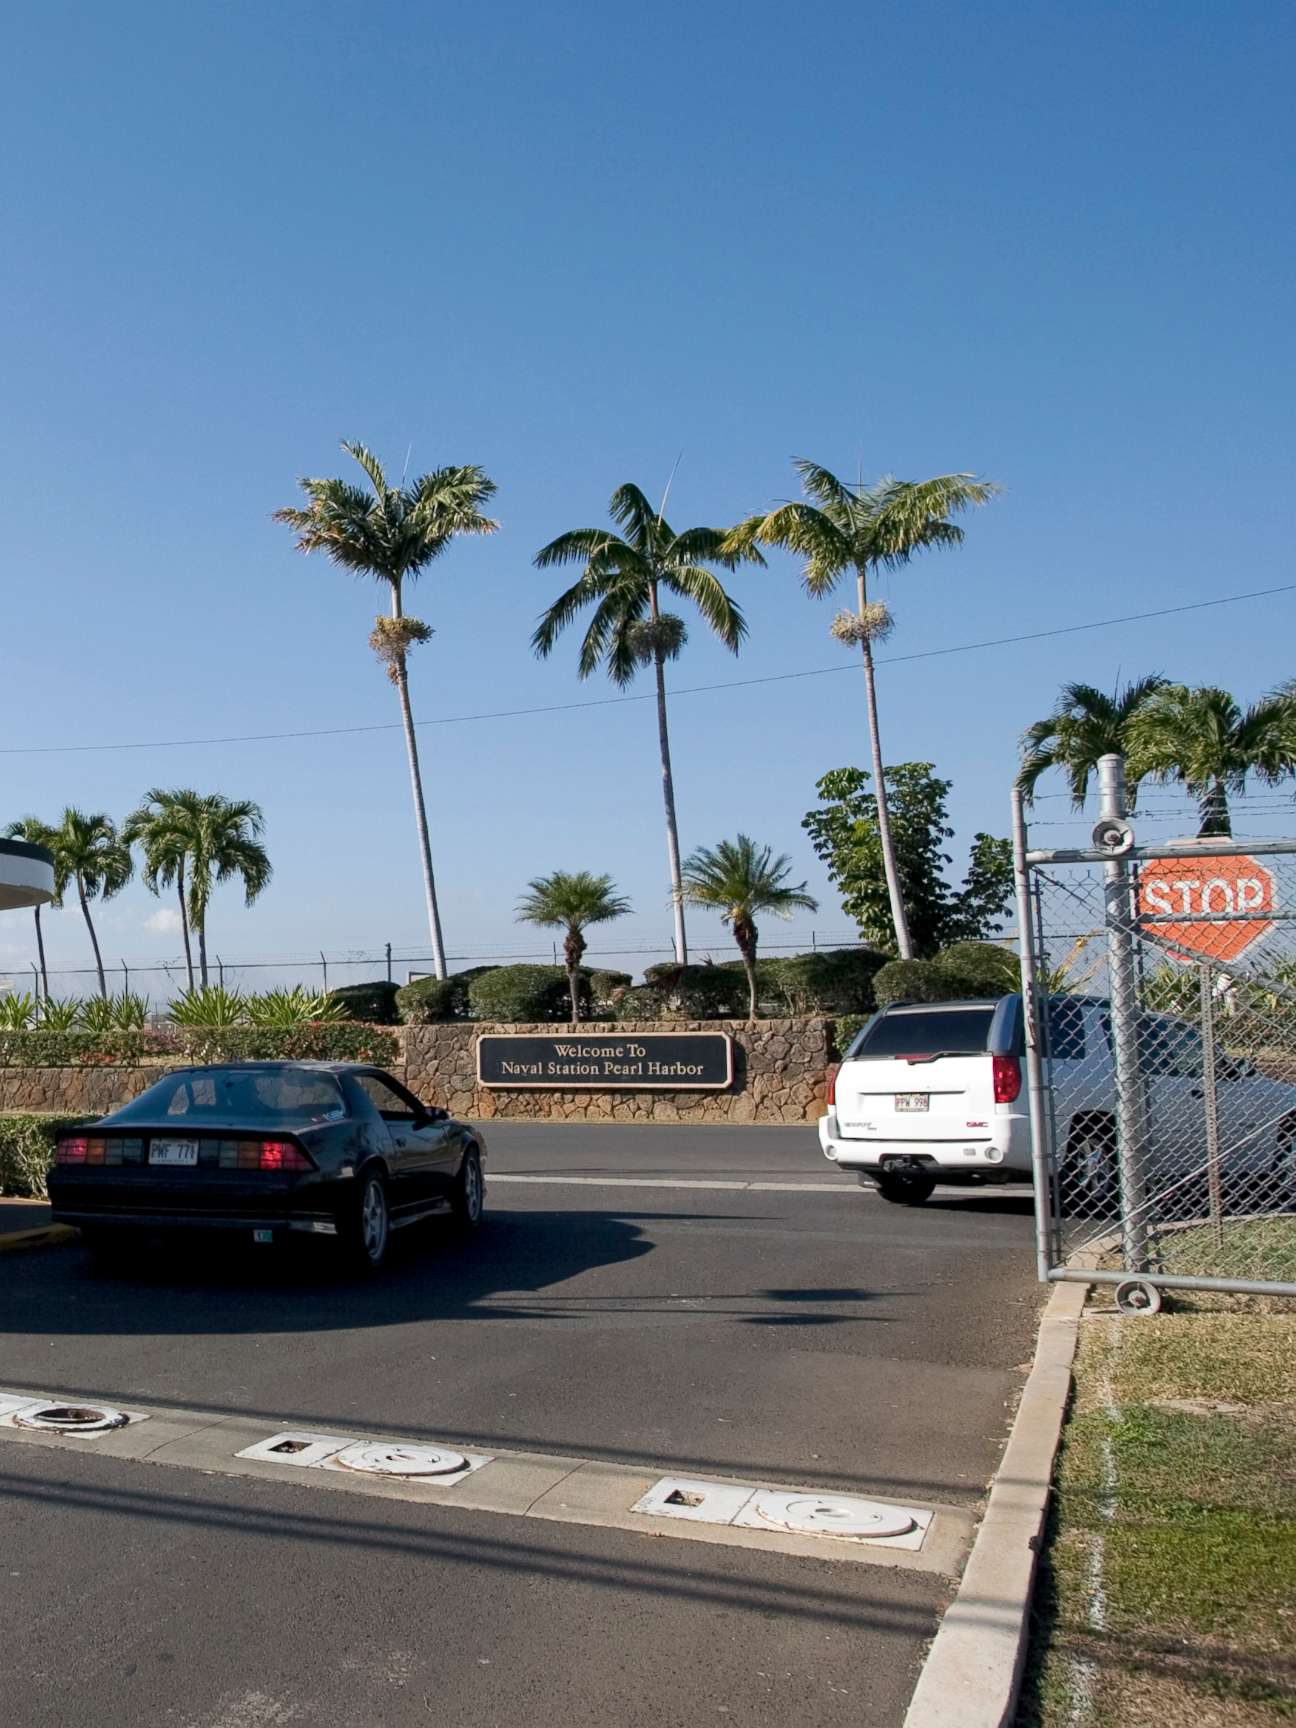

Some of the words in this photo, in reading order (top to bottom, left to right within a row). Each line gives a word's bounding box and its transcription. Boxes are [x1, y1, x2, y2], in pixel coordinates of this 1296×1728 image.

[1145, 877, 1264, 925] STOP
[554, 1043, 624, 1058] Welcome
[625, 1043, 647, 1058] To
[501, 1061, 543, 1075] Naval
[547, 1061, 600, 1075] Station
[603, 1062, 643, 1075] Pearl
[647, 1062, 705, 1076] Harbor
